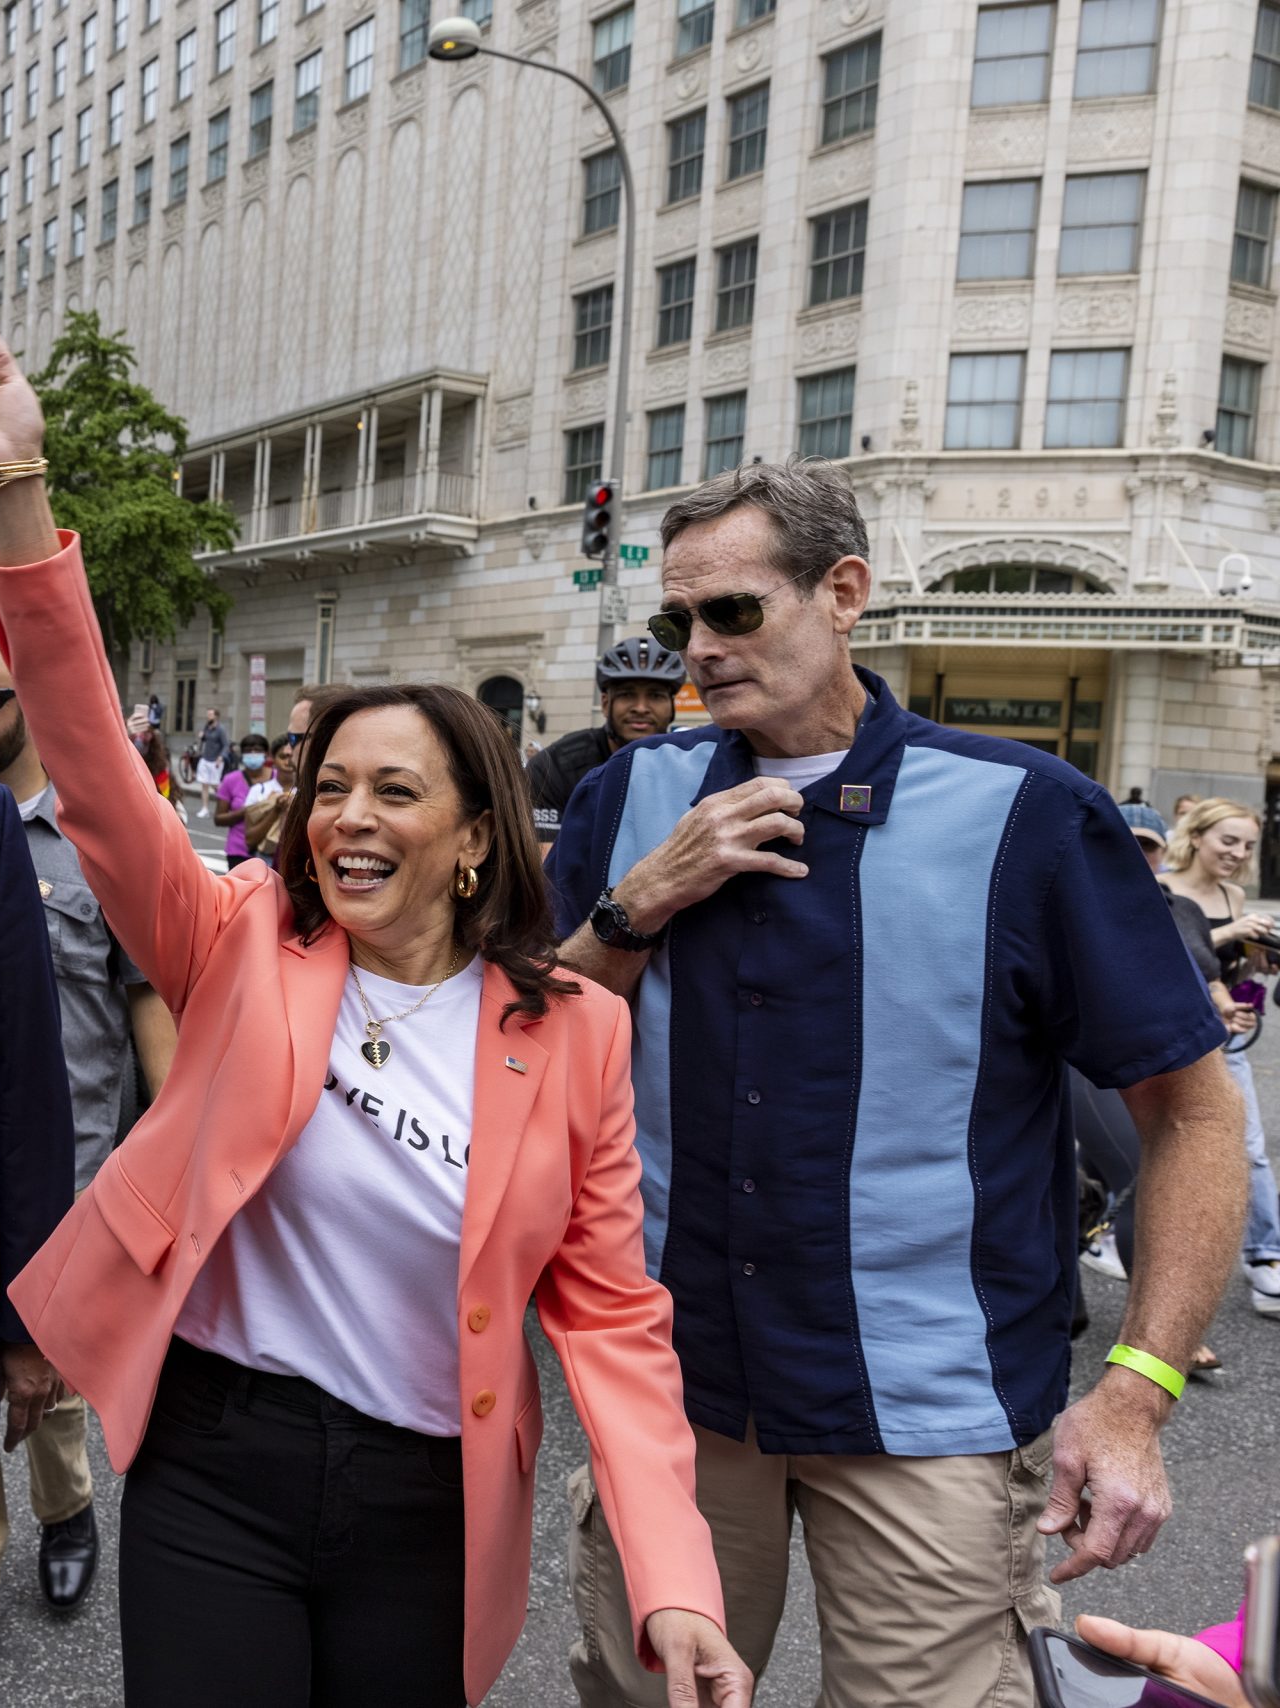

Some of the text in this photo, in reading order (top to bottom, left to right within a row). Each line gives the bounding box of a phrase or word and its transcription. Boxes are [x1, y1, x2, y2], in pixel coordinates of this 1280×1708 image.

[966, 486, 1088, 509] 1299
[952, 703, 1052, 719] WARNER
[393, 1108, 430, 1151] IS
[442, 1134, 471, 1169] L
